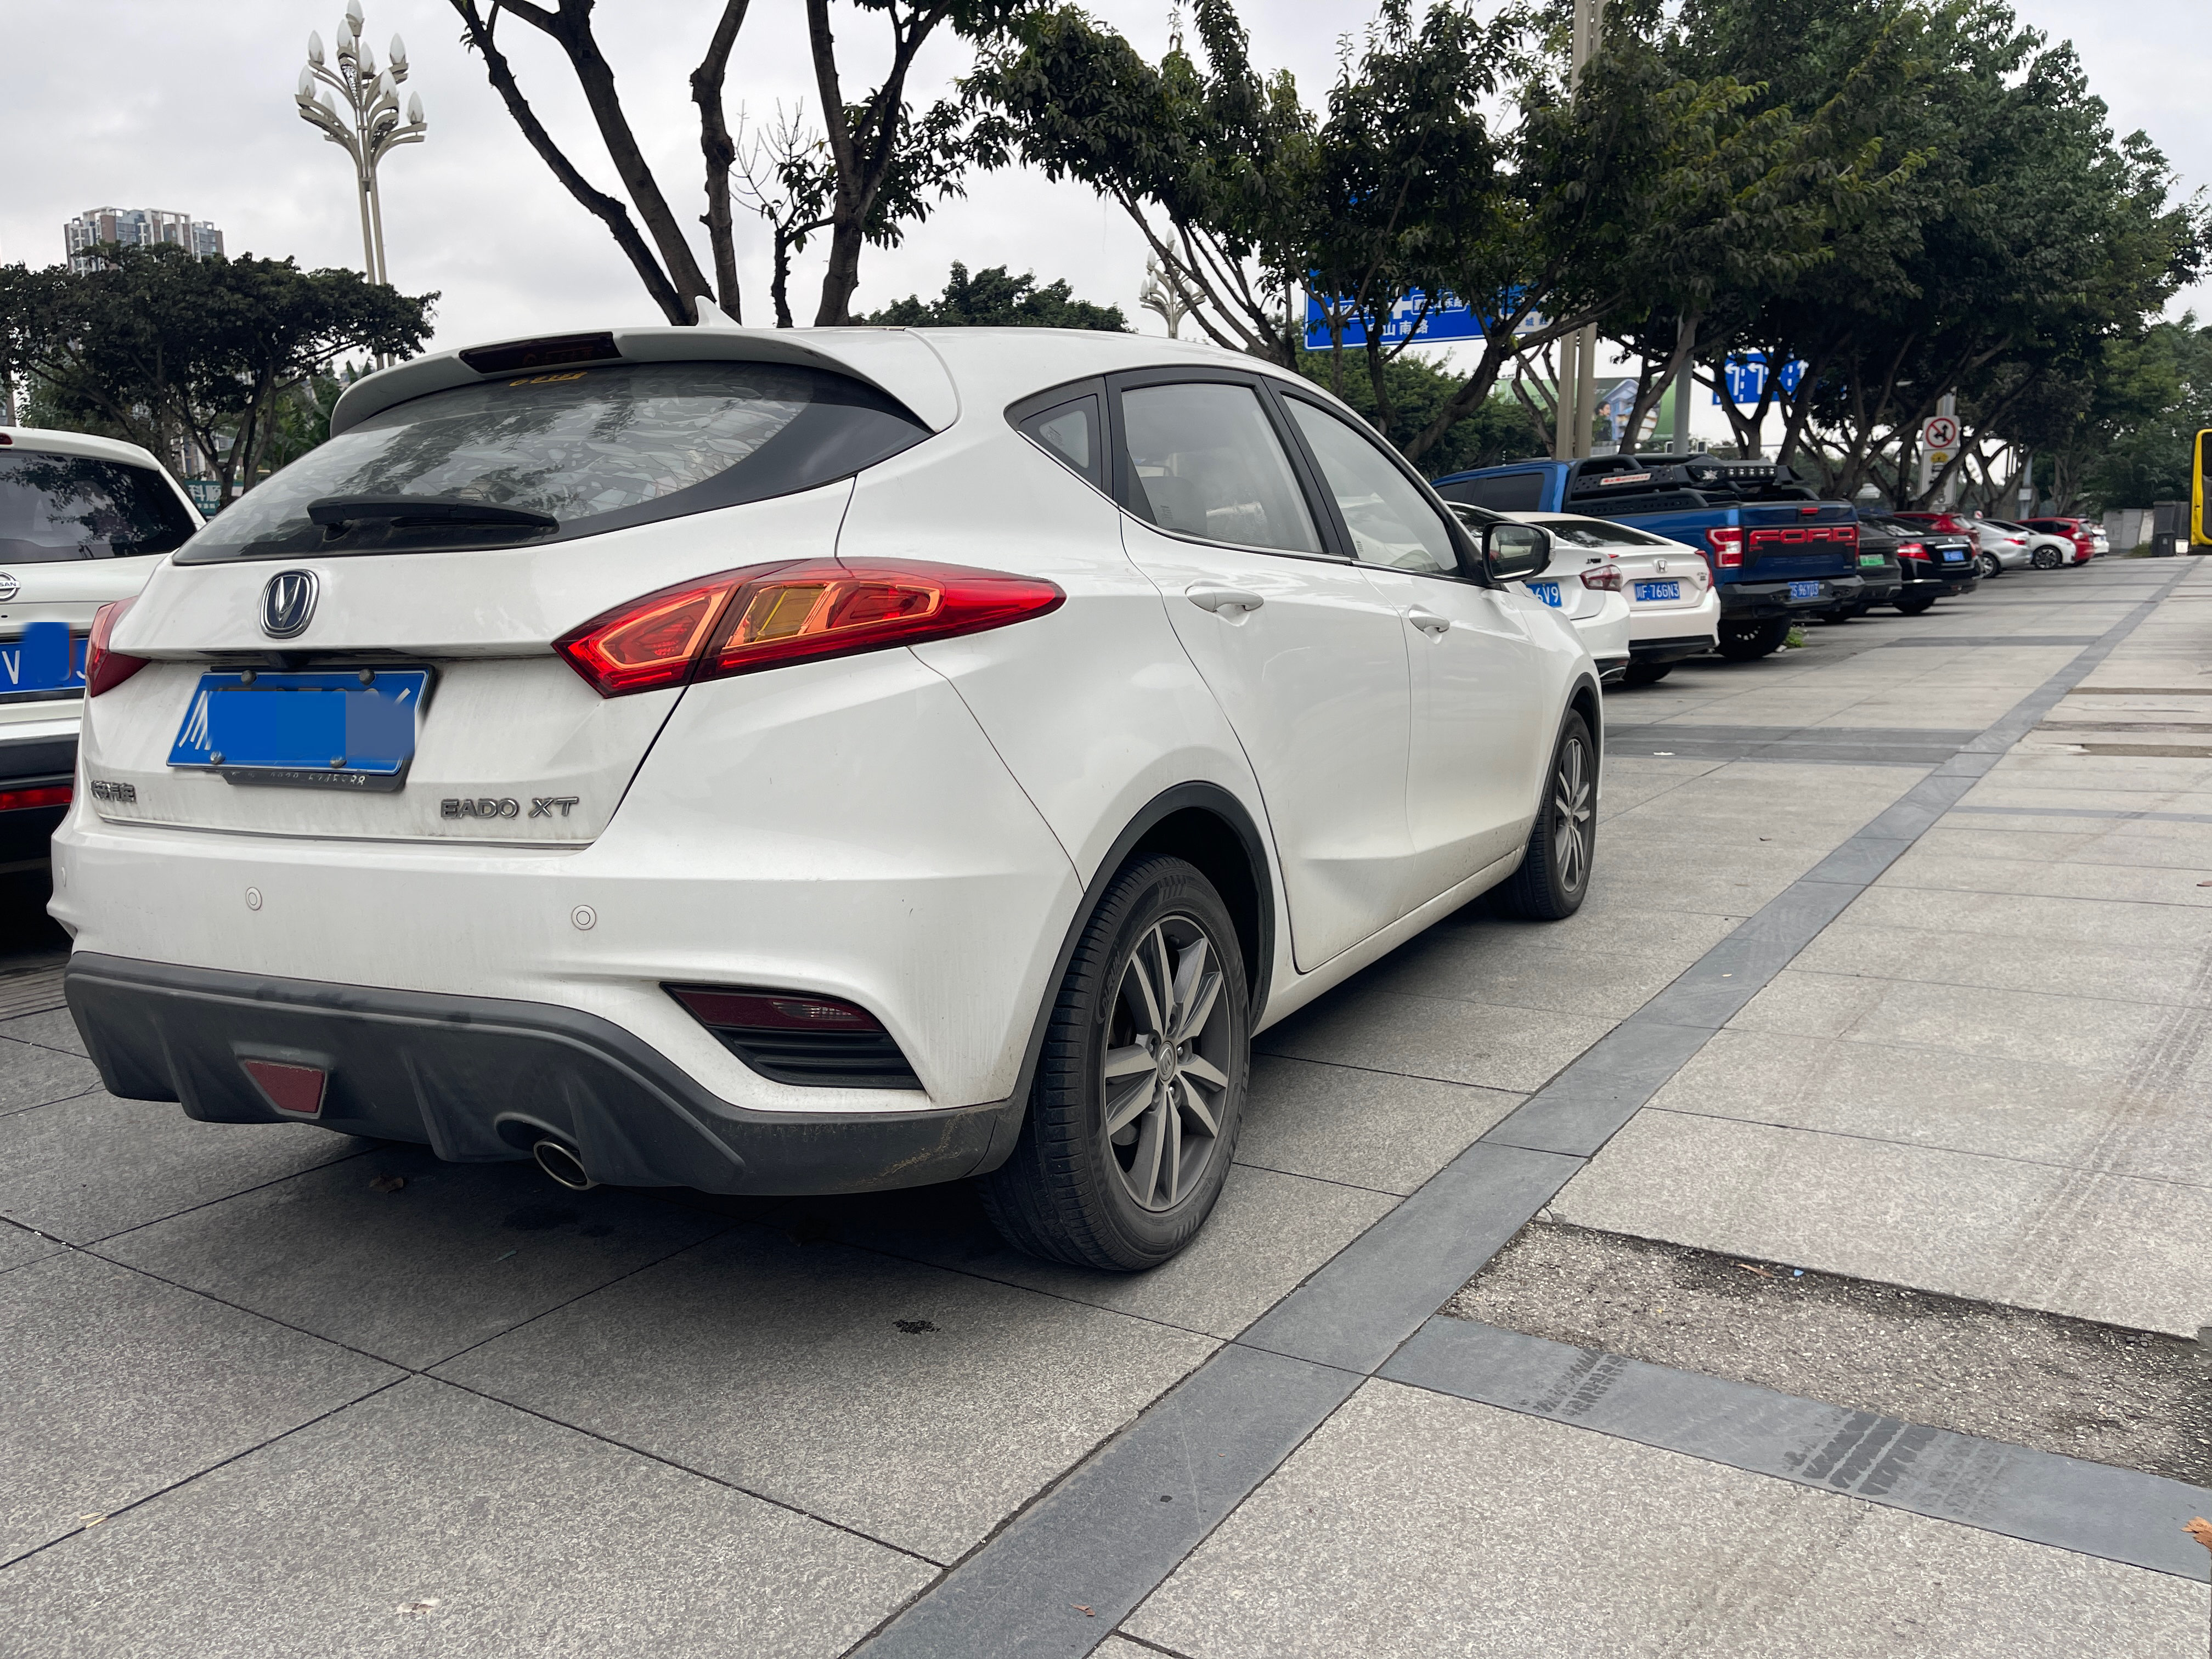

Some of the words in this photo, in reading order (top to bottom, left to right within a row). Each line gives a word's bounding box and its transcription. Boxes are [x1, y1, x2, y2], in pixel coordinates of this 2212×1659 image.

[1749, 527, 1855, 544] FORD
[441, 798, 519, 819] EADO
[528, 796, 579, 819] XT
